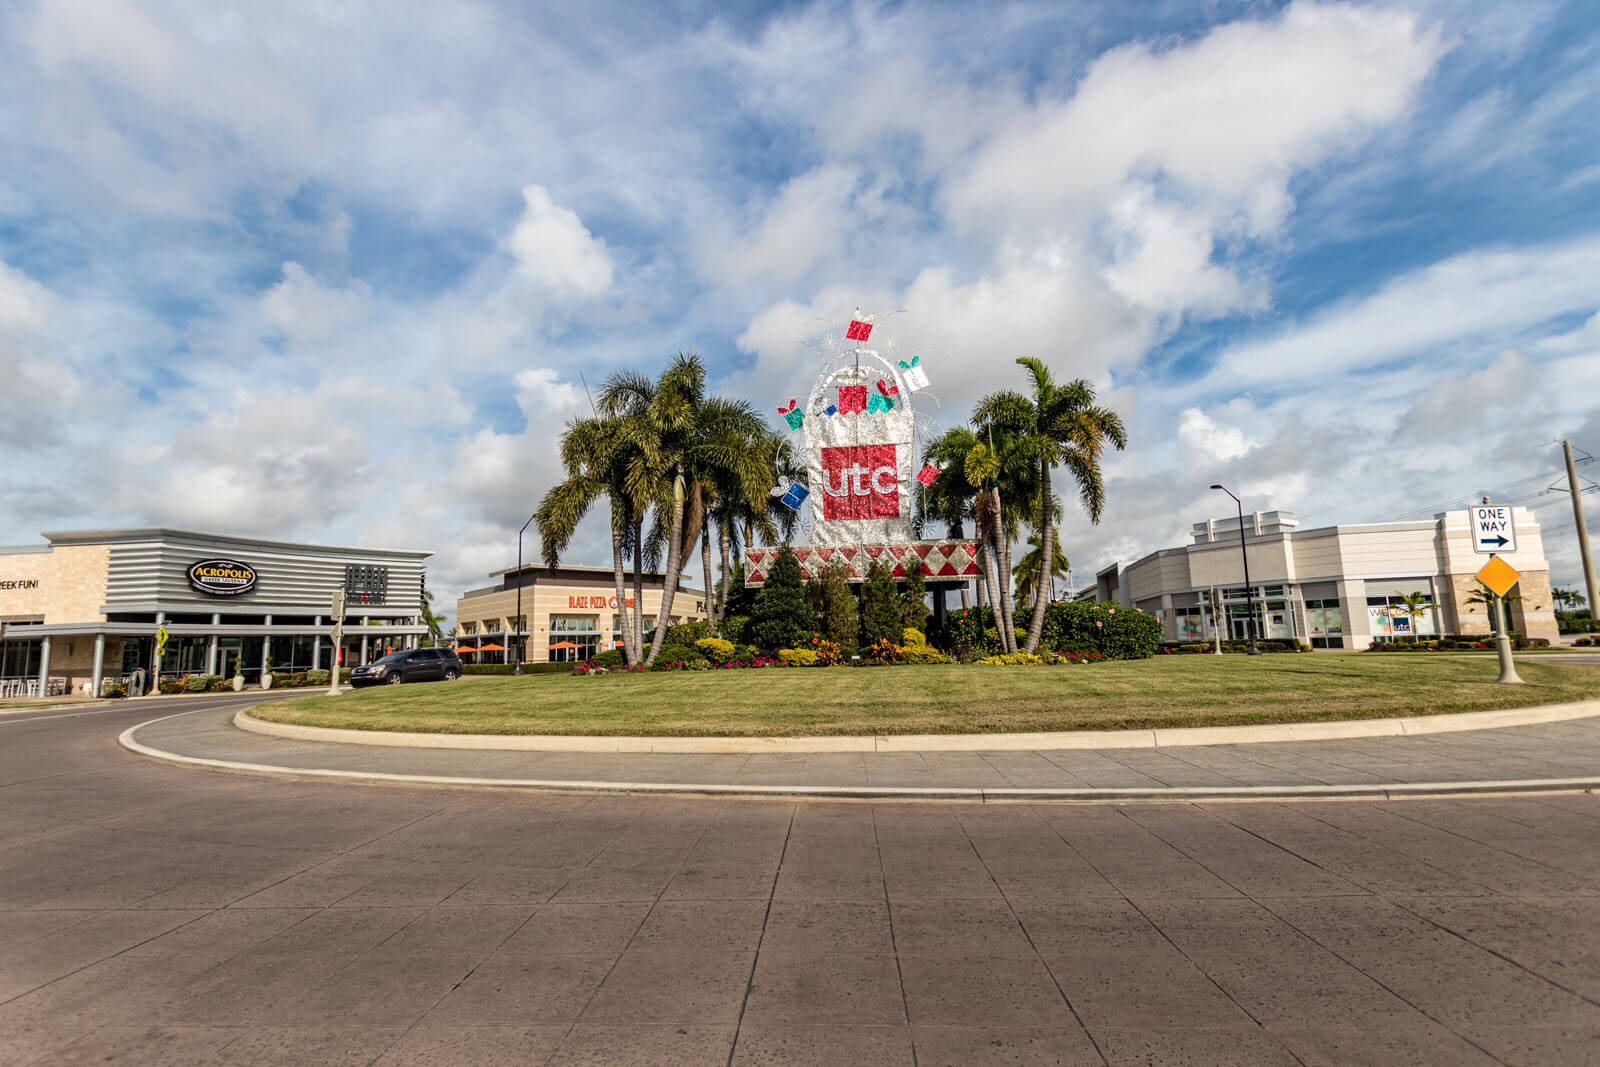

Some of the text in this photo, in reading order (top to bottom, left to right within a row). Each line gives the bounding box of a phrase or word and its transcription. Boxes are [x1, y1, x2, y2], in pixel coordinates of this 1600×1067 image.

[823, 462, 897, 497] utc
[1478, 508, 1505, 519] ONE
[1480, 521, 1507, 532] WAY
[195, 567, 252, 579] ACROPOLIS
[0, 579, 39, 590] EEK FUN!
[568, 596, 607, 608] BLAZE PIZZA
[1395, 623, 1410, 631] utc
